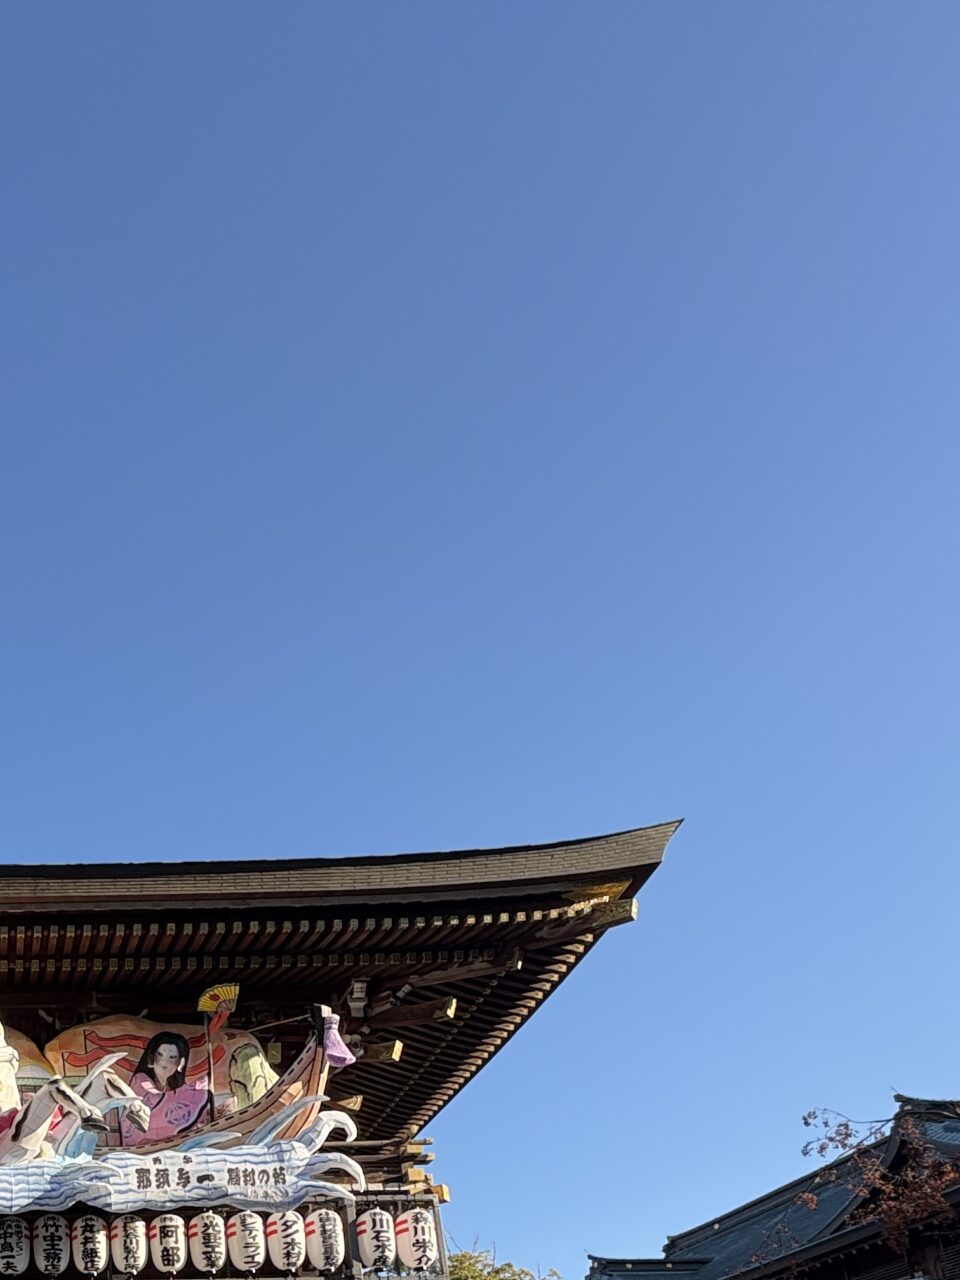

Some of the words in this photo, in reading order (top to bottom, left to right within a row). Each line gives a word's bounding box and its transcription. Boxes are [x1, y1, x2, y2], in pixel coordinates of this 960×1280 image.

[135, 1167, 215, 1190] 那須与一
[411, 1212, 434, 1266] 森川栄介
